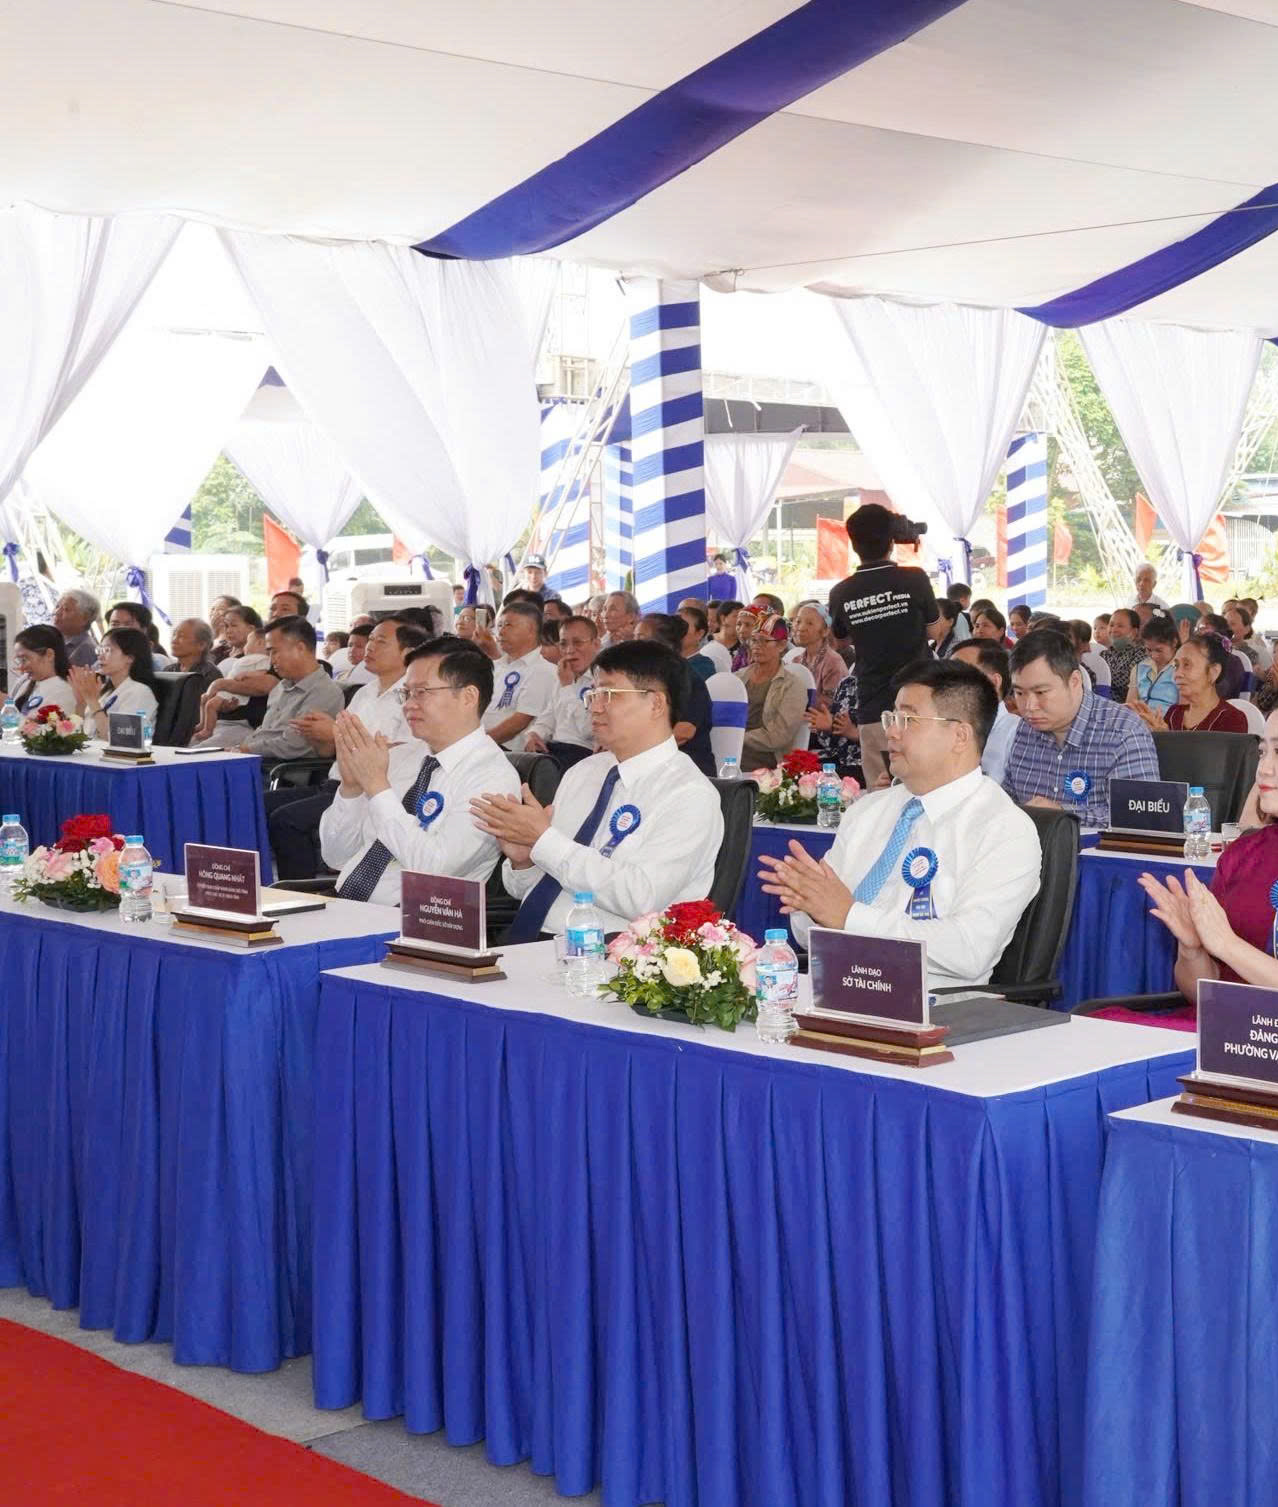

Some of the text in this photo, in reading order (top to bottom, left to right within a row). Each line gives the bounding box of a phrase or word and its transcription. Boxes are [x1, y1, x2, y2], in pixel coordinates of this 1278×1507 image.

[844, 591, 892, 612] PERFECT
[1128, 798, 1170, 813] ĐẠI BIỂU
[420, 904, 463, 919] NGUYỄN VĂN HÀ
[851, 965, 882, 978] LÃNH ĐẠO
[842, 975, 892, 992] SỞ TÀI CHÍNH
[1252, 1015, 1273, 1027] LÃNH
[1250, 1029, 1278, 1044] ĐẢNG
[1224, 1042, 1268, 1059] PHƯỜNG
